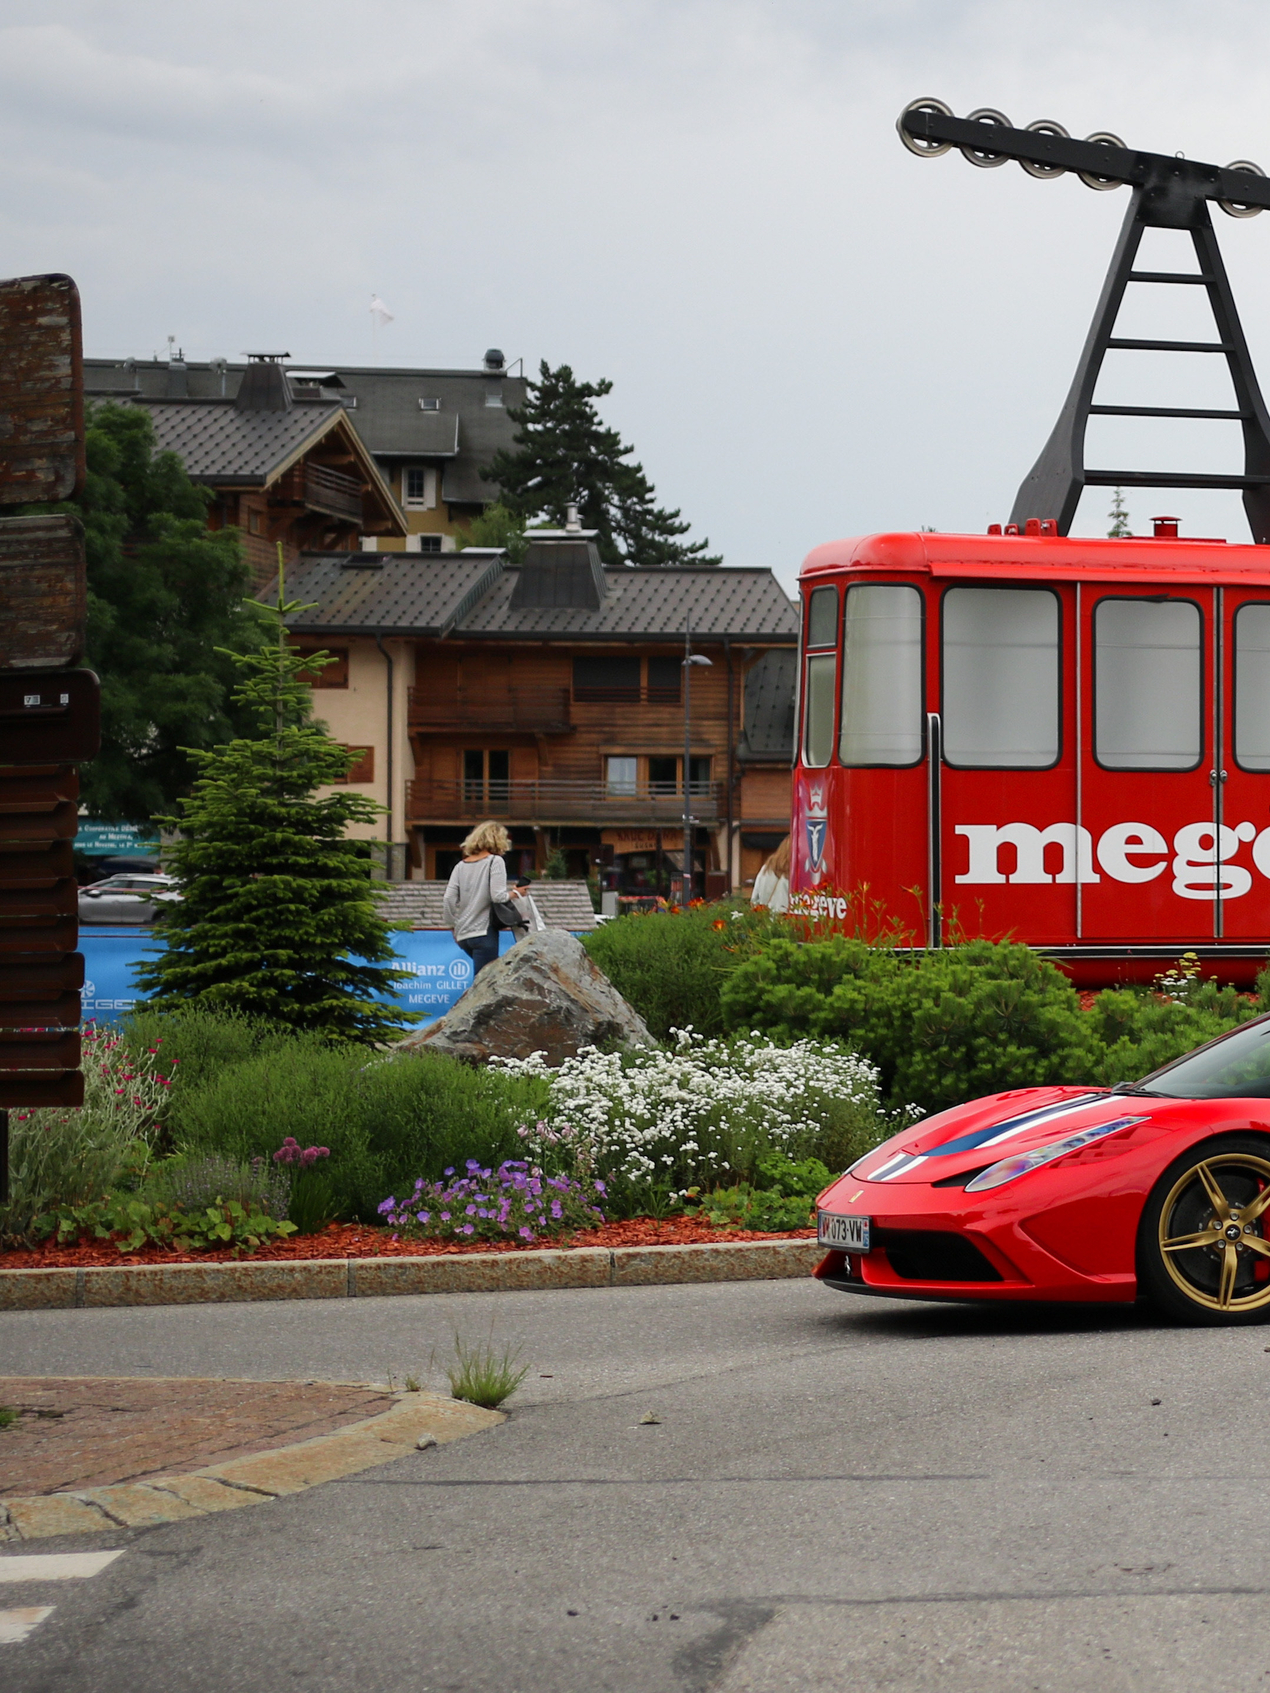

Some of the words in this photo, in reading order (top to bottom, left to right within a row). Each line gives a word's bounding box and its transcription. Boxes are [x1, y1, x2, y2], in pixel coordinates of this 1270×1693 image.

[391, 961, 446, 976] Allianz
[436, 980, 468, 990] GILLET
[408, 994, 450, 1004] MEGEVE
